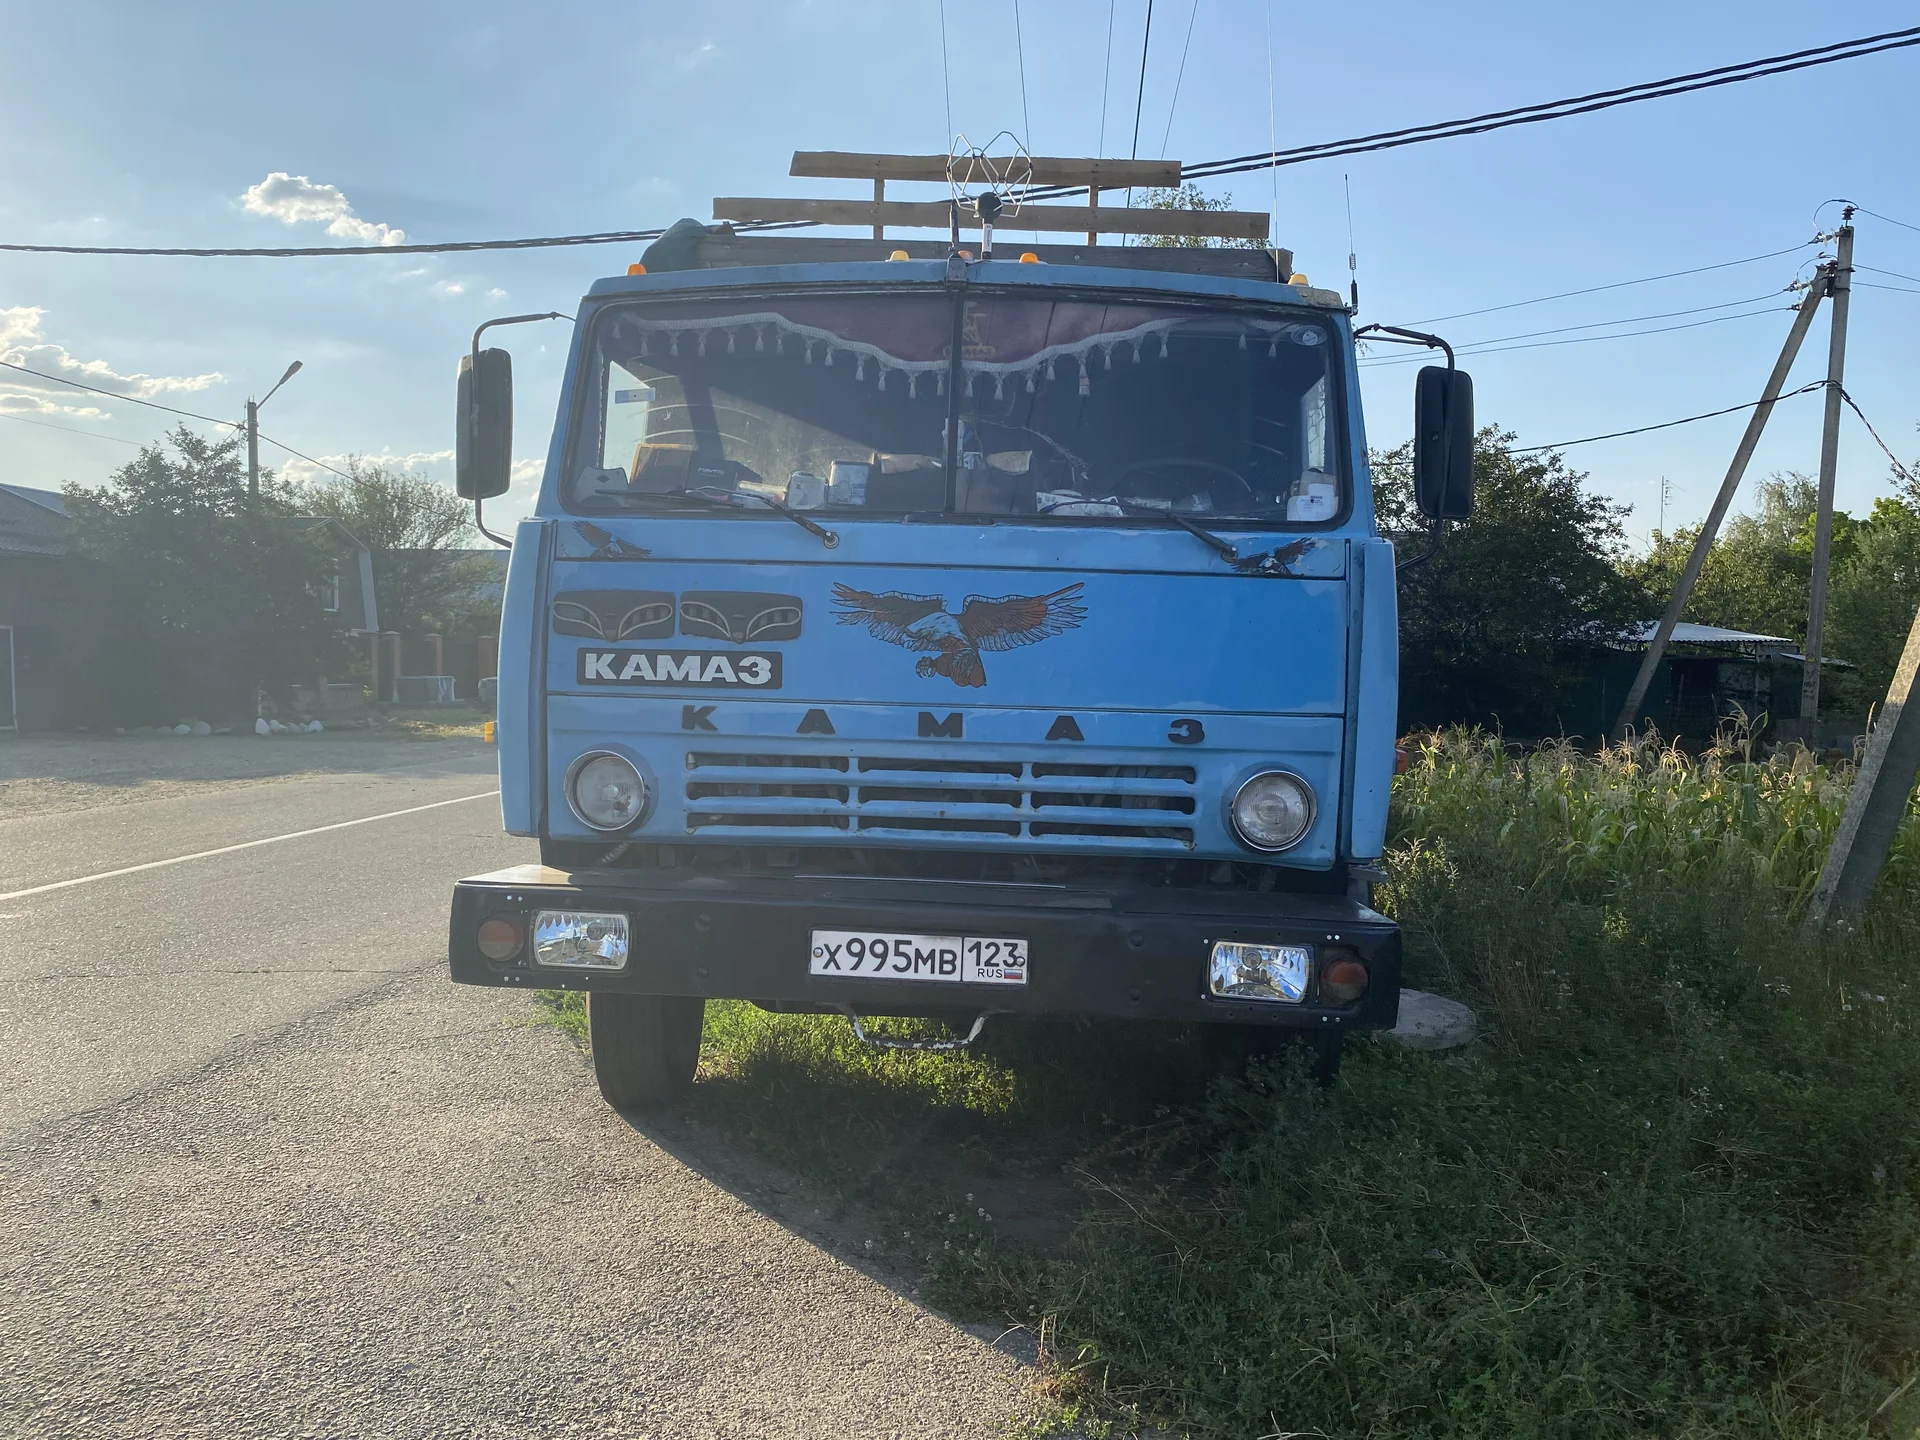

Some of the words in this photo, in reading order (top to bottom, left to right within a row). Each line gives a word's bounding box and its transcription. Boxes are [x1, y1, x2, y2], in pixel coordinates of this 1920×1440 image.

[584, 652, 772, 685] КАМАЗ
[822, 937, 957, 975] Х995МВ
[967, 940, 1019, 968] 123
[977, 967, 1003, 979] RUS
